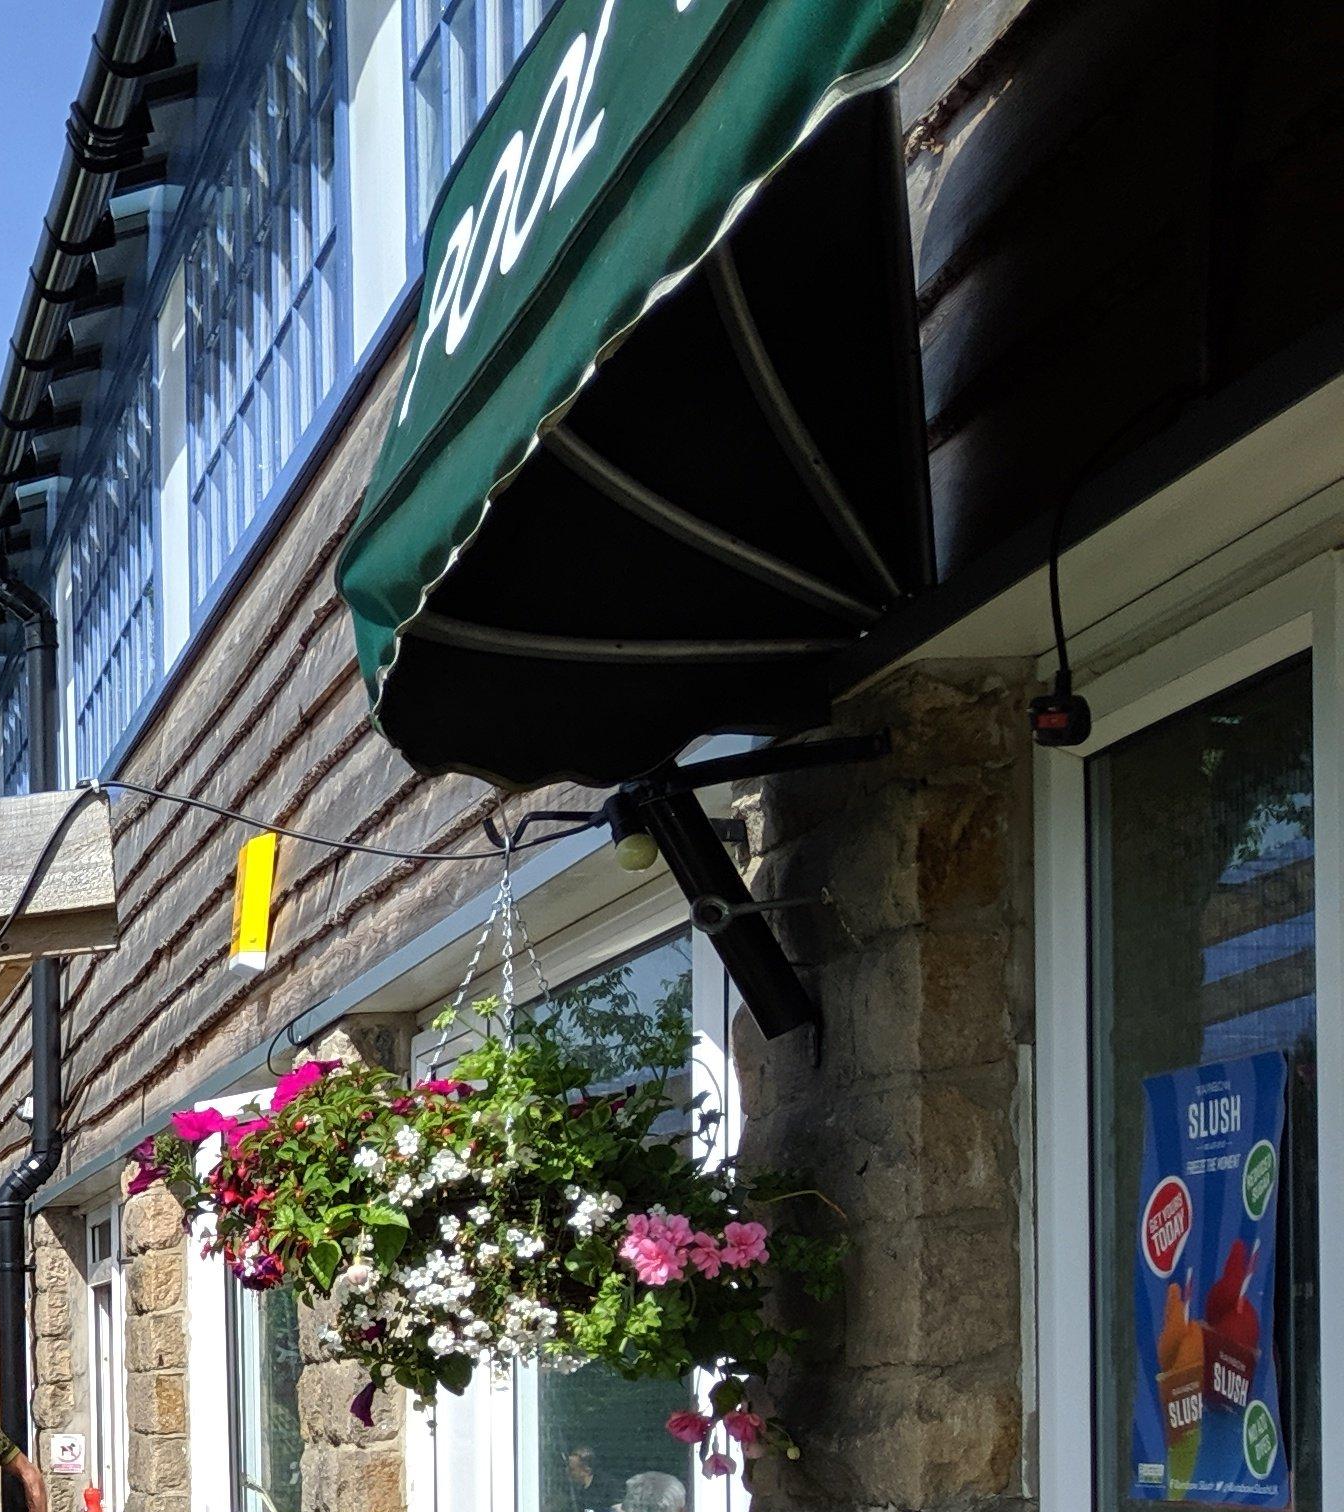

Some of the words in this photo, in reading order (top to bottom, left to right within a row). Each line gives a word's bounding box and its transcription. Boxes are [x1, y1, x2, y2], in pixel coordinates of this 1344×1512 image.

[399, 0, 613, 426] POOL
[1188, 1094, 1241, 1139] SLUSH
[1151, 1207, 1185, 1257] TODAY
[1214, 1361, 1250, 1407] SLUSH
